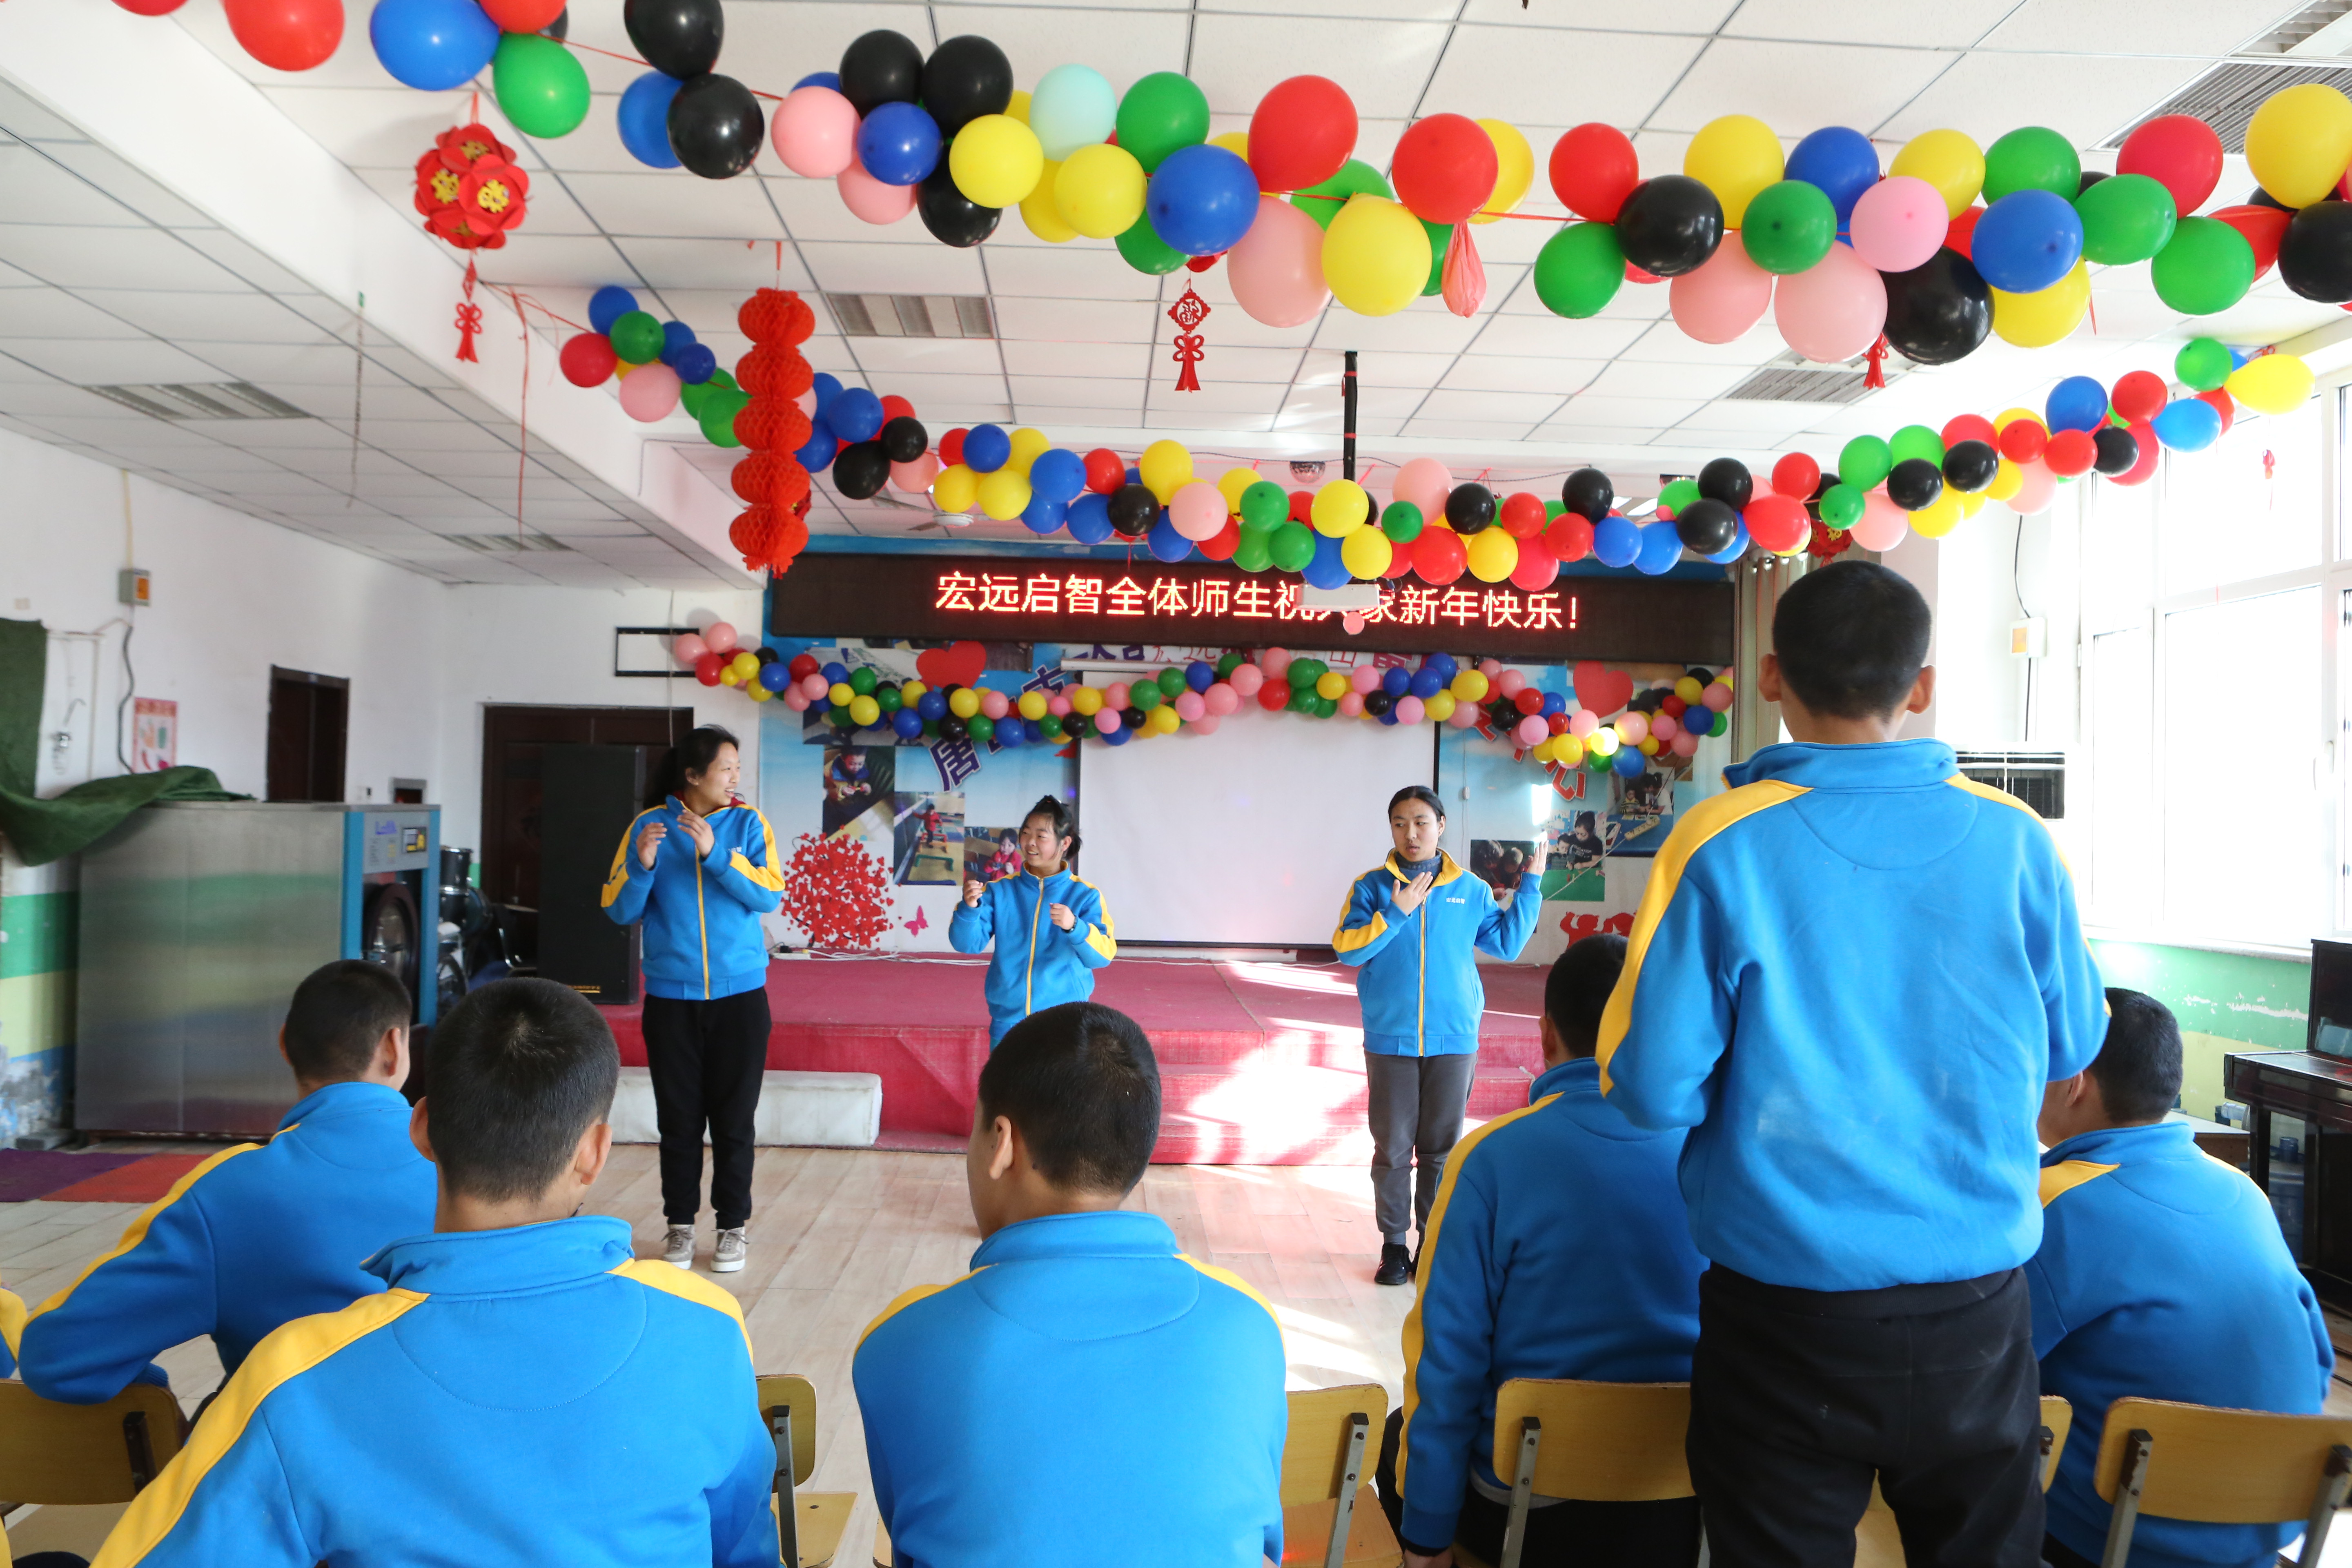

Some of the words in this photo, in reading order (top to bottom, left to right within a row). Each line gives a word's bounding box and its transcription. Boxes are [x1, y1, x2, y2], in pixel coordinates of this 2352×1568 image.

[935, 570, 1577, 629] 宏远启智全体师生祝家新年快乐!
